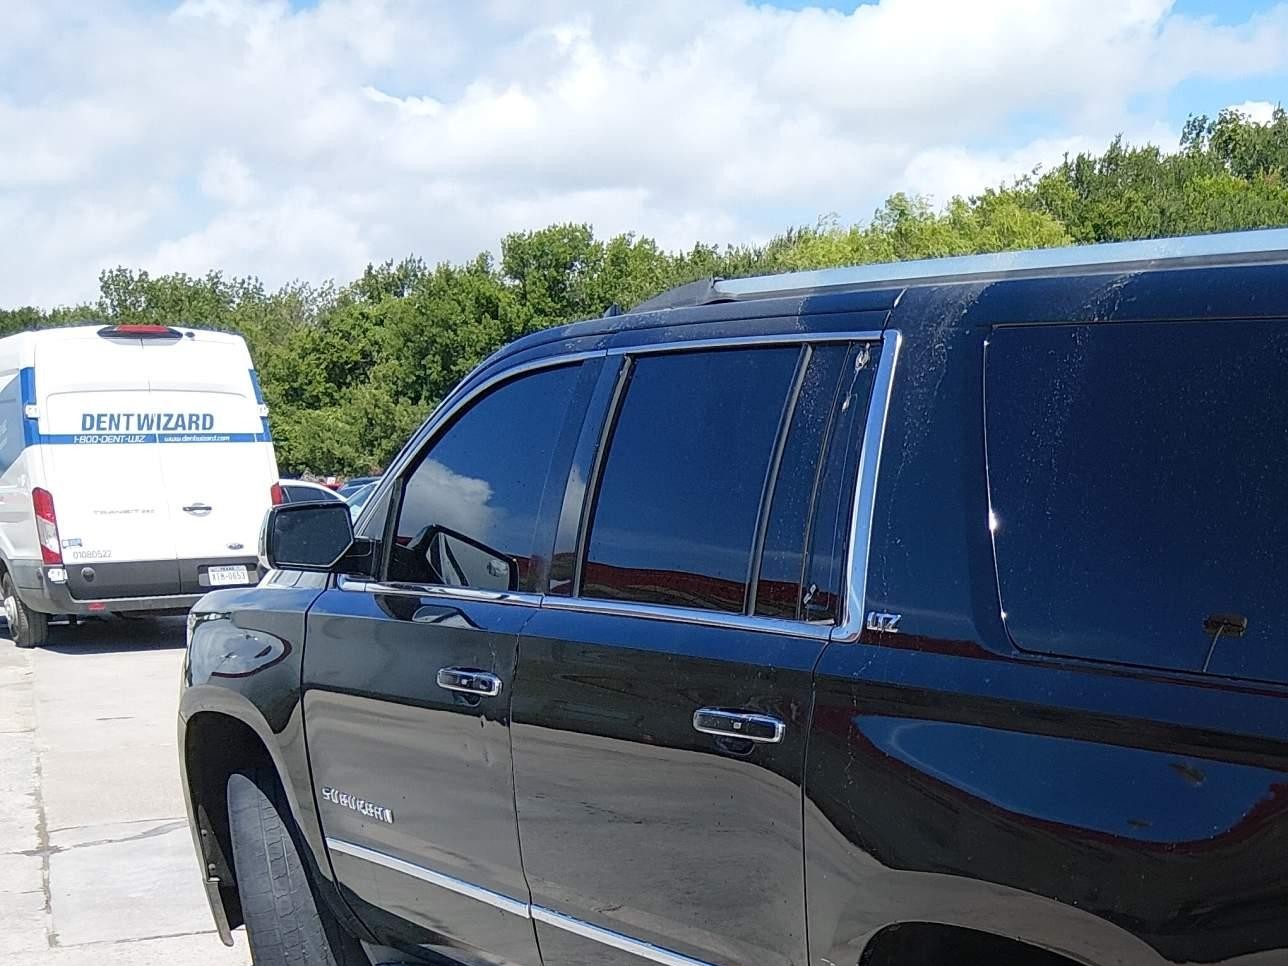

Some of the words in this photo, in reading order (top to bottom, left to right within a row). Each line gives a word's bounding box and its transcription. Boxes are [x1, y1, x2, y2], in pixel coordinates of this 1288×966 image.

[81, 413, 134, 431] DENT
[137, 413, 214, 431] WIZARD
[867, 612, 902, 633] LTZ
[322, 787, 393, 824] SUBURBAN
